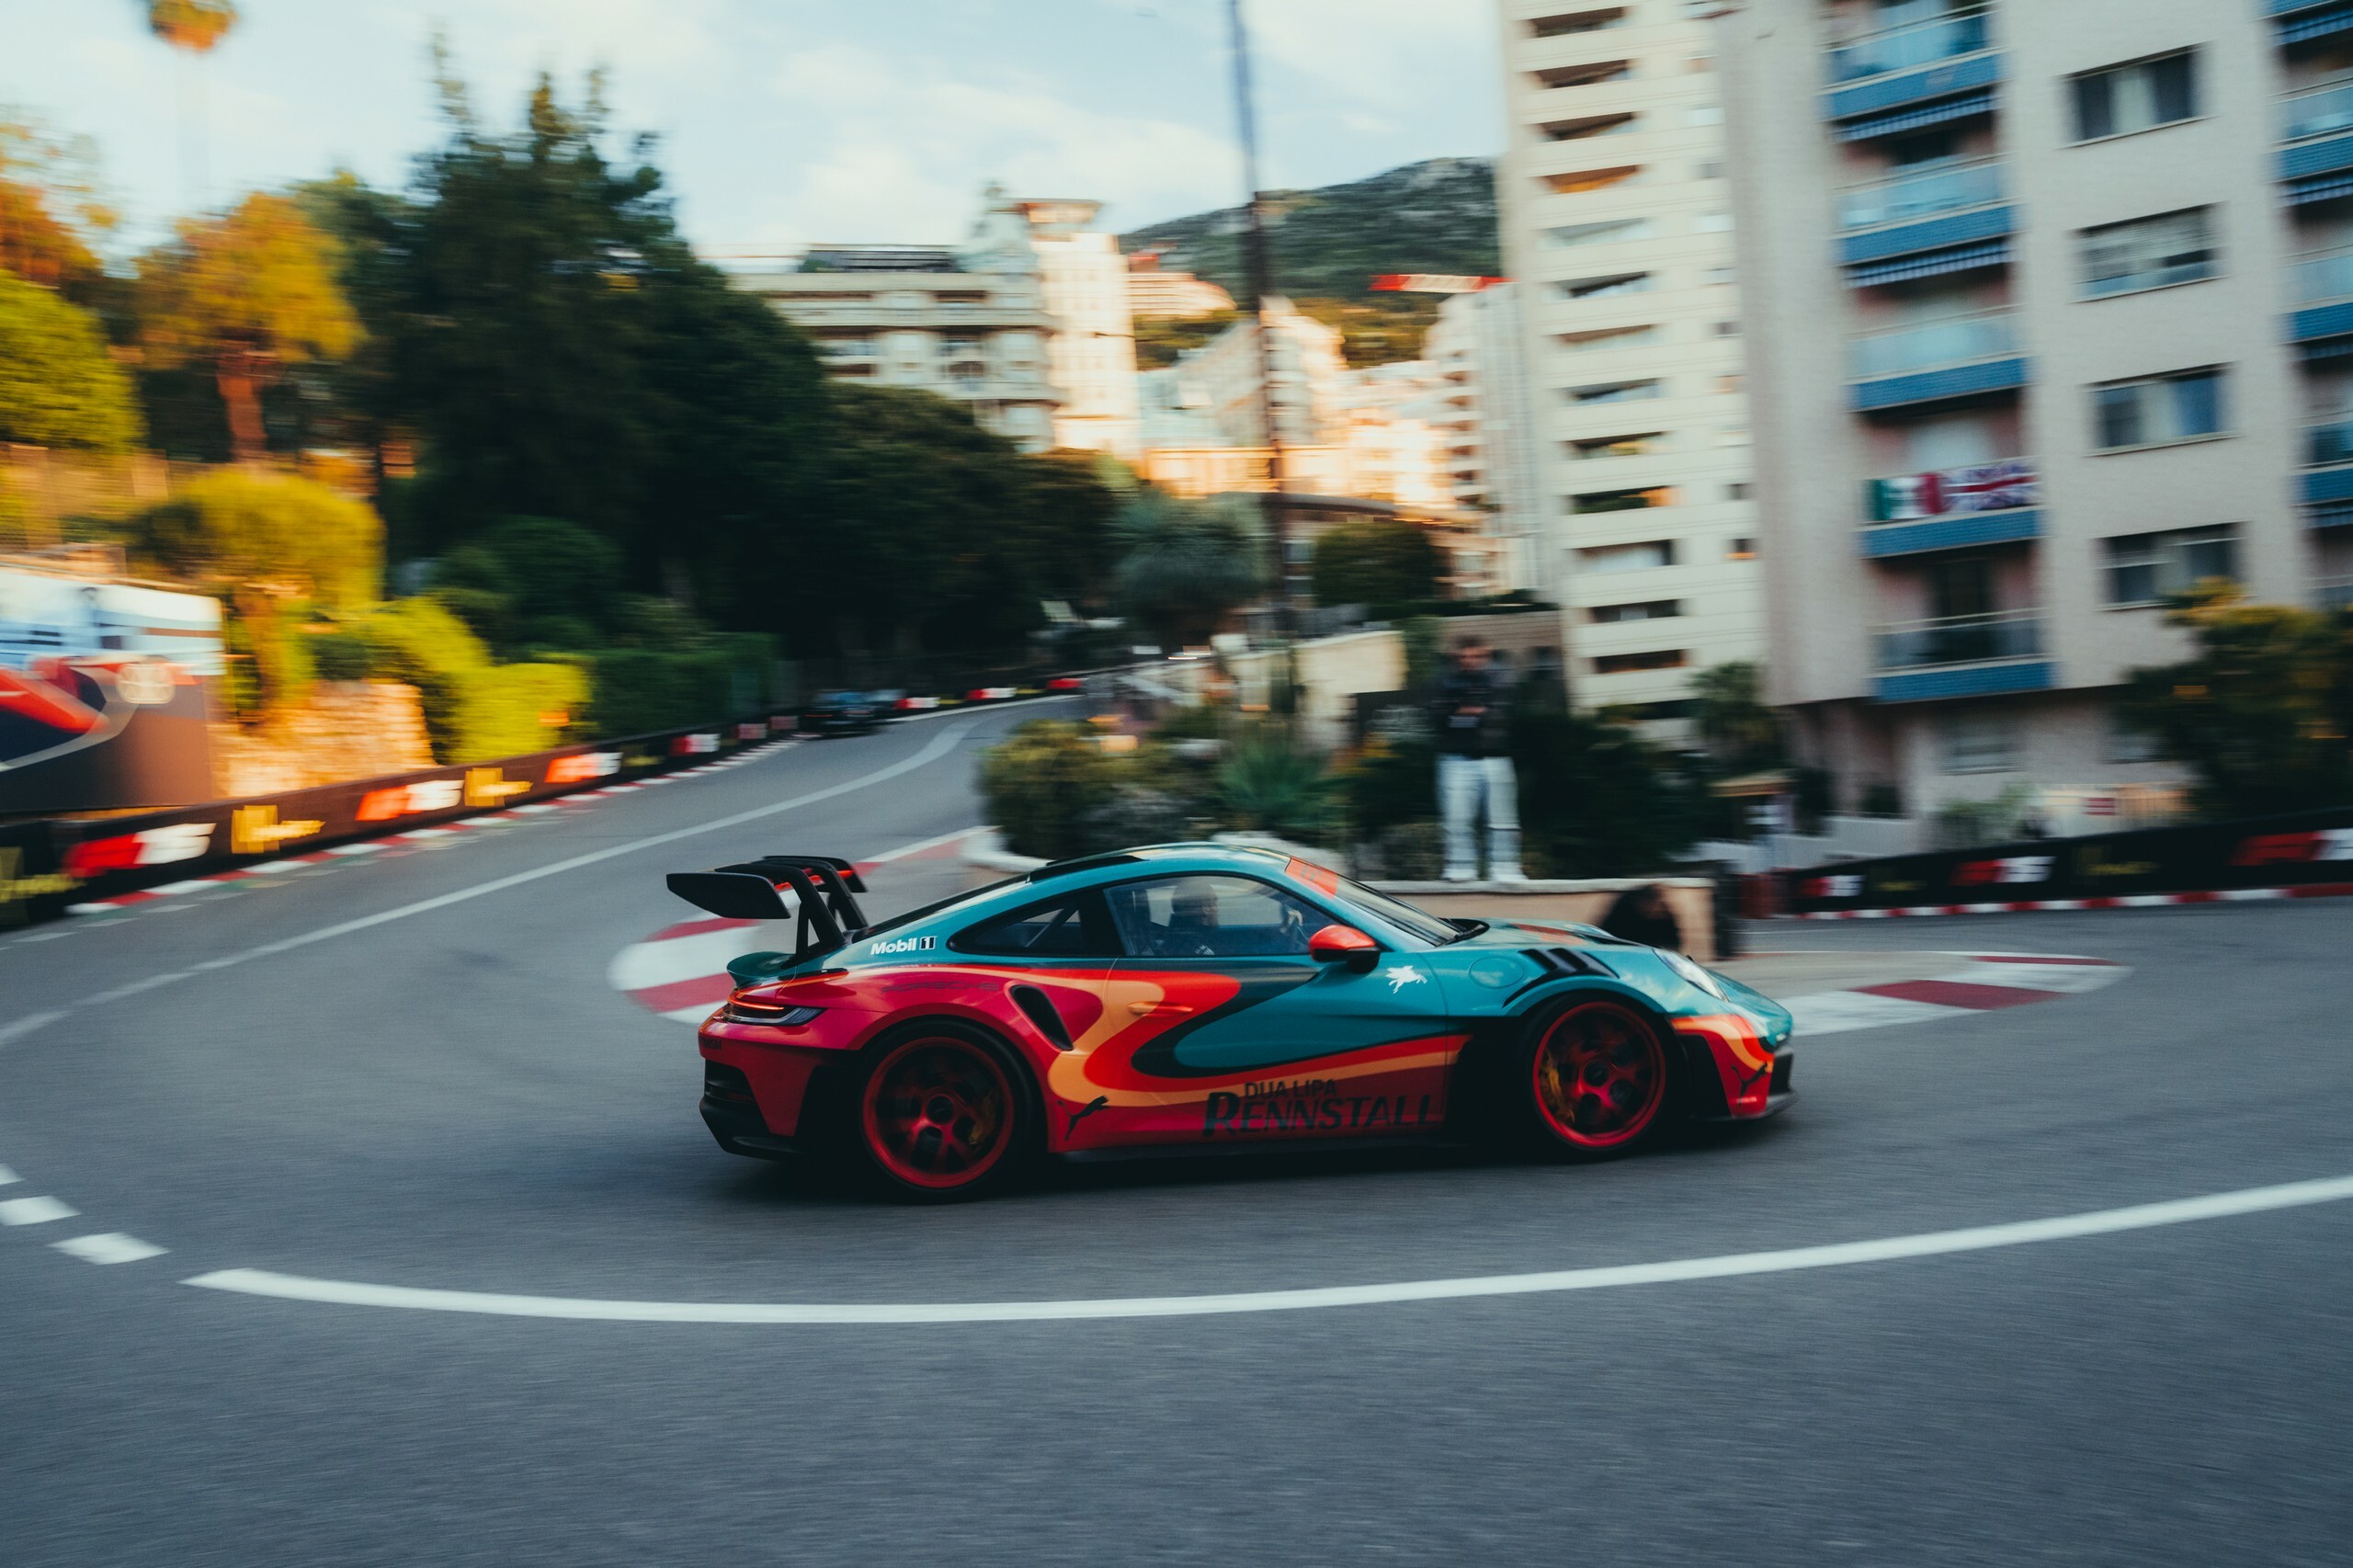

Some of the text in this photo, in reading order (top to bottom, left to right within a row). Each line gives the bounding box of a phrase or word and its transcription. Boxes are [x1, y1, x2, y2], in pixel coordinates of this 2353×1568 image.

[870, 937, 936, 955] Mobil 1
[1244, 1078, 1337, 1100] DUA LIPA
[1202, 1091, 1439, 1138] RENNSTALL
